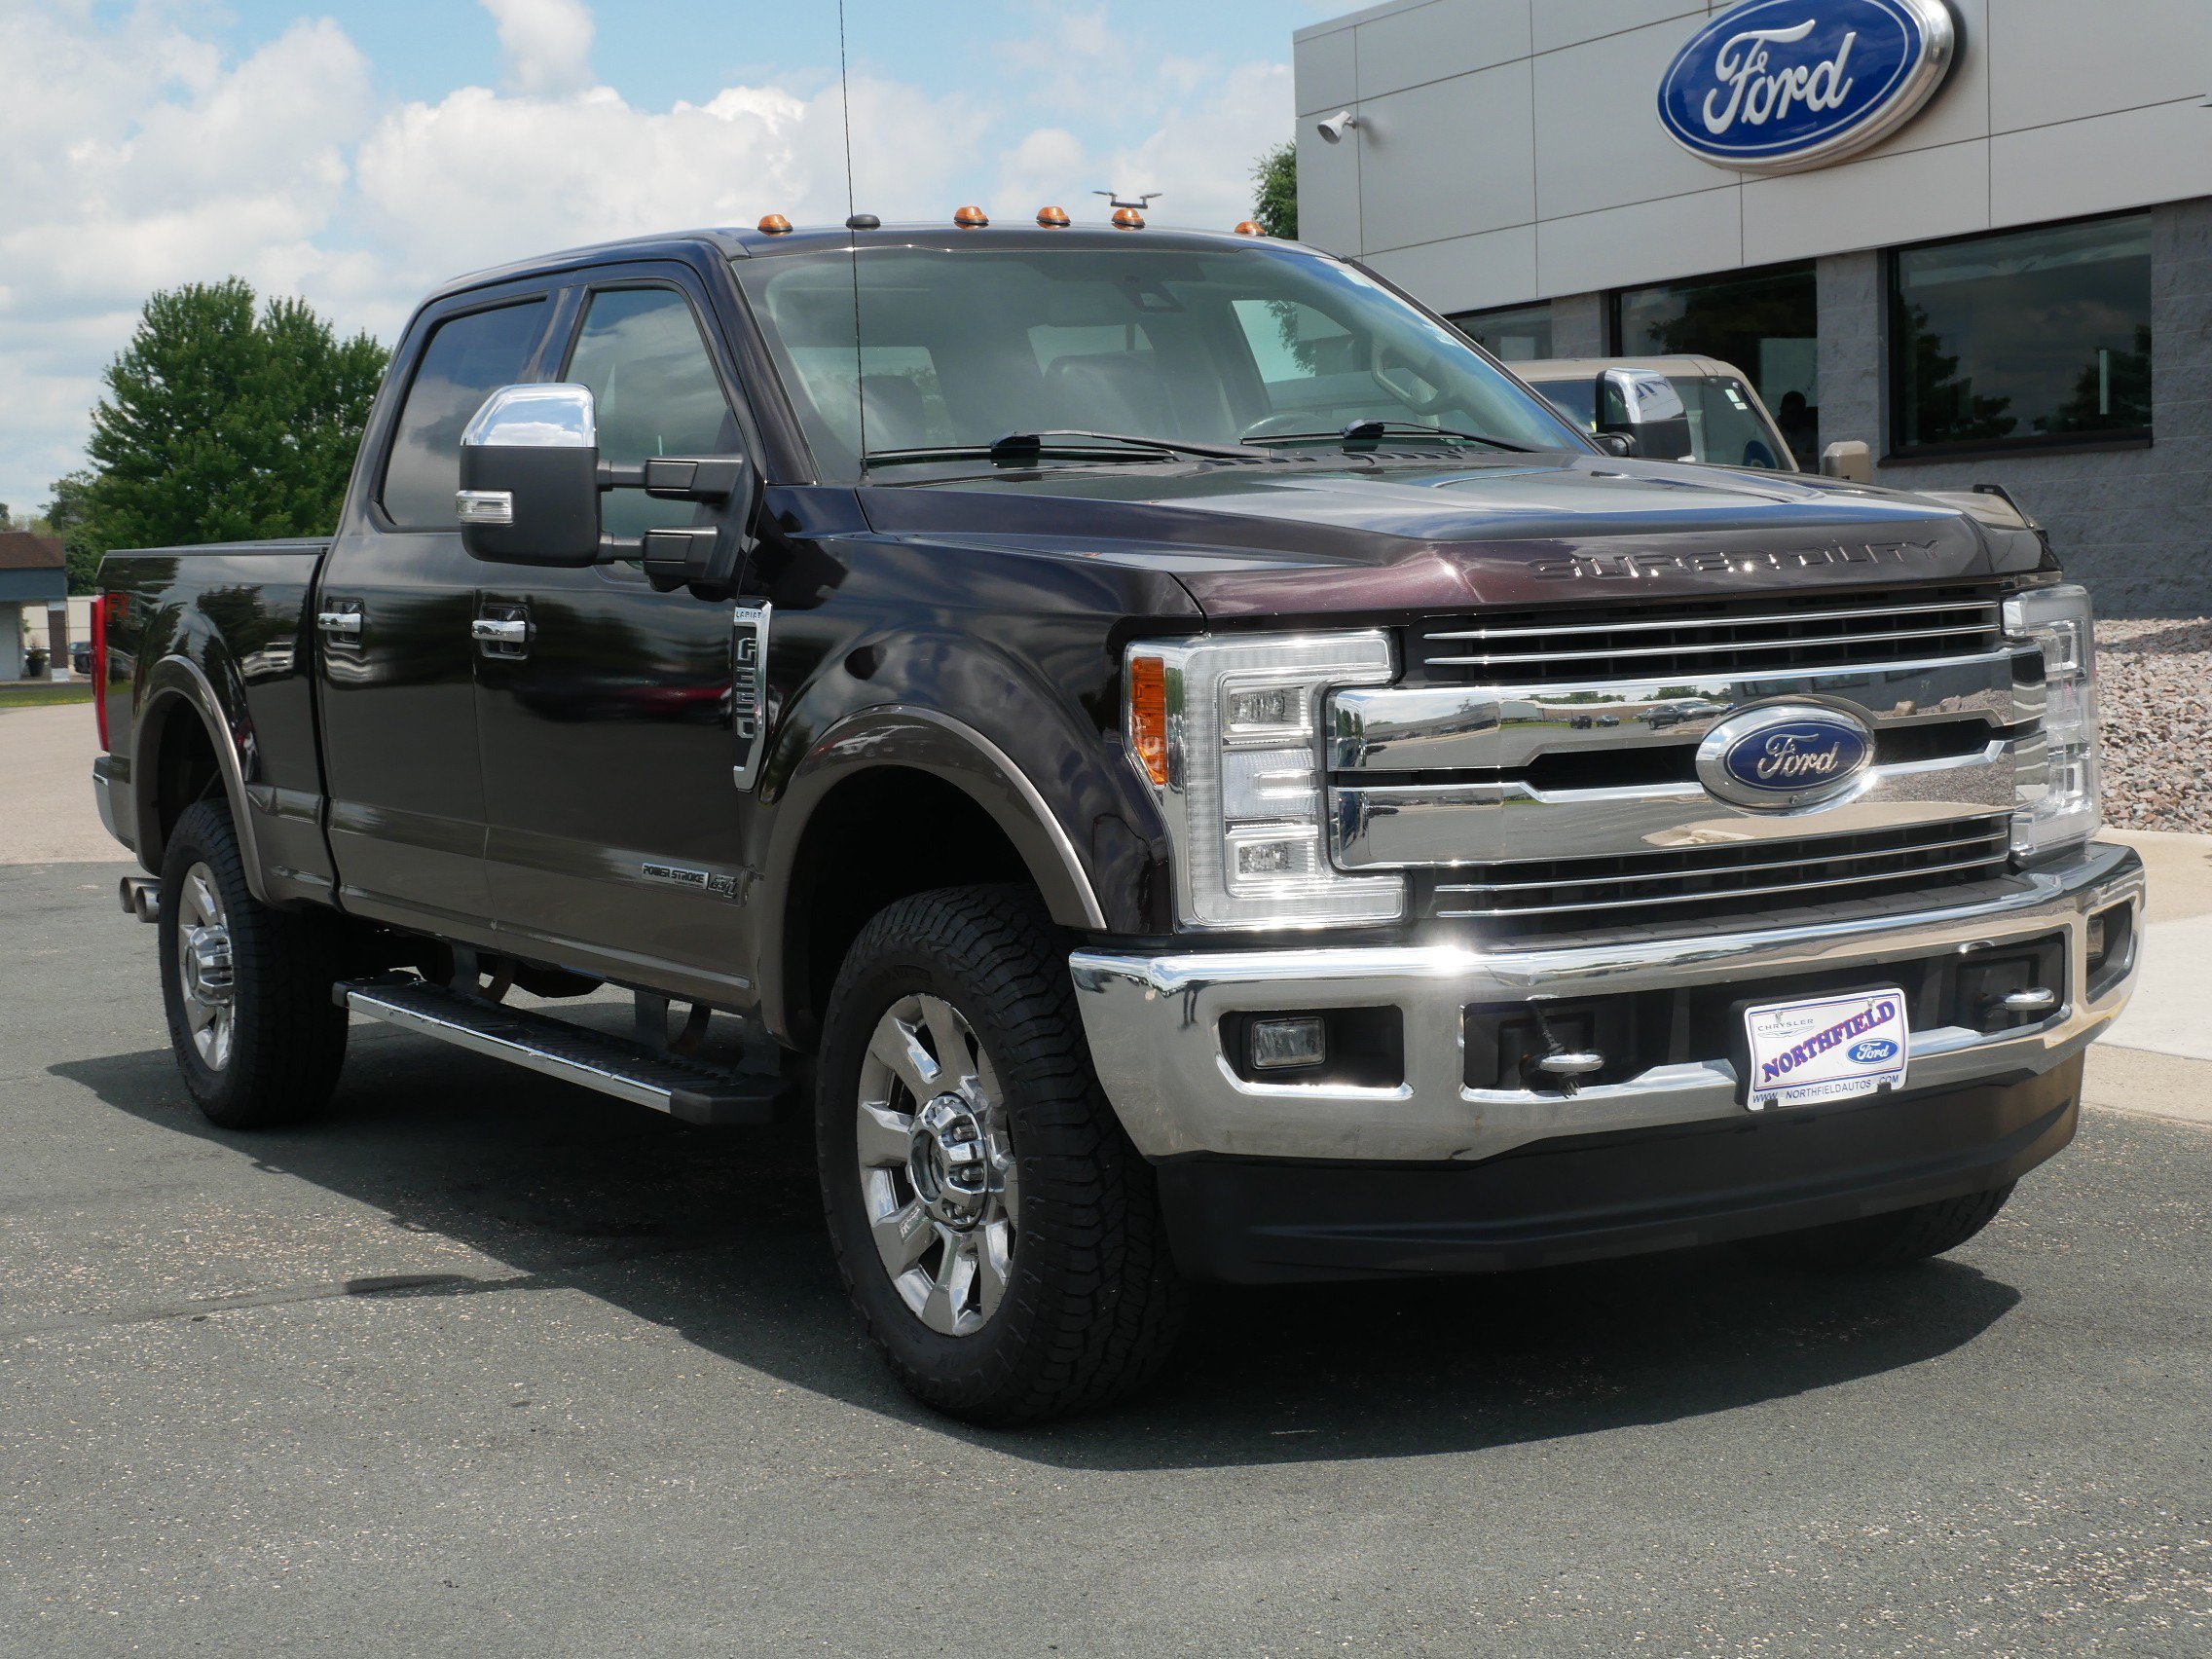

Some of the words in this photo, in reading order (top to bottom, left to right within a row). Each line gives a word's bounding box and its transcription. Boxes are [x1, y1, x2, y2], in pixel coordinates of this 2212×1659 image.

[1704, 18, 1857, 134] Ford
[1529, 550, 1781, 582] SUPER
[1787, 538, 1940, 566] DUTY
[736, 610, 762, 619] LARIAT
[1757, 732, 1840, 779] Ford
[643, 865, 671, 878] POWER
[671, 869, 705, 884] STROKE
[1757, 1018, 1814, 1032] CHRYSLER
[1762, 1000, 1896, 1083] NORTHFIELD
[1857, 1042, 1889, 1060] Ford
